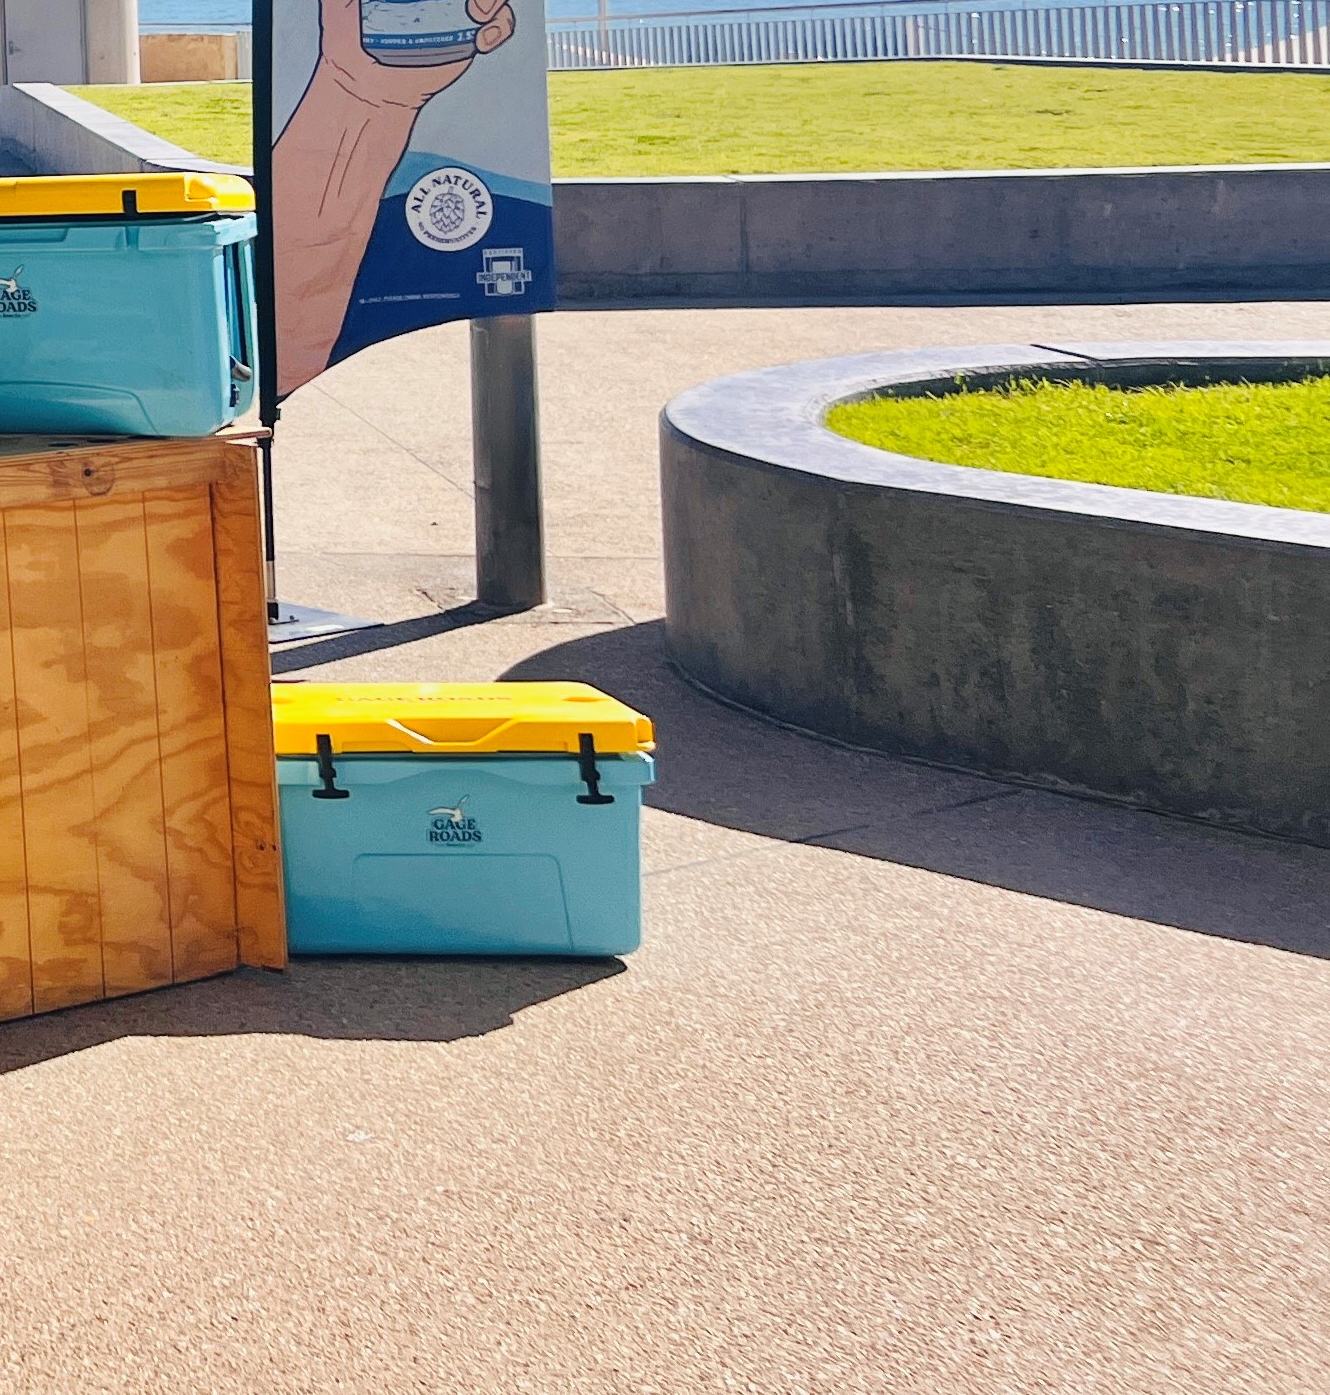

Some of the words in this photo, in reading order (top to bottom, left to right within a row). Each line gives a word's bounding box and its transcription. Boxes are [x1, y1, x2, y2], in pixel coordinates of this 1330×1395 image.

[411, 186, 432, 214] ALL
[432, 174, 488, 220] NATURAL
[433, 818, 477, 831] GAGE
[429, 830, 483, 843] ROADS
